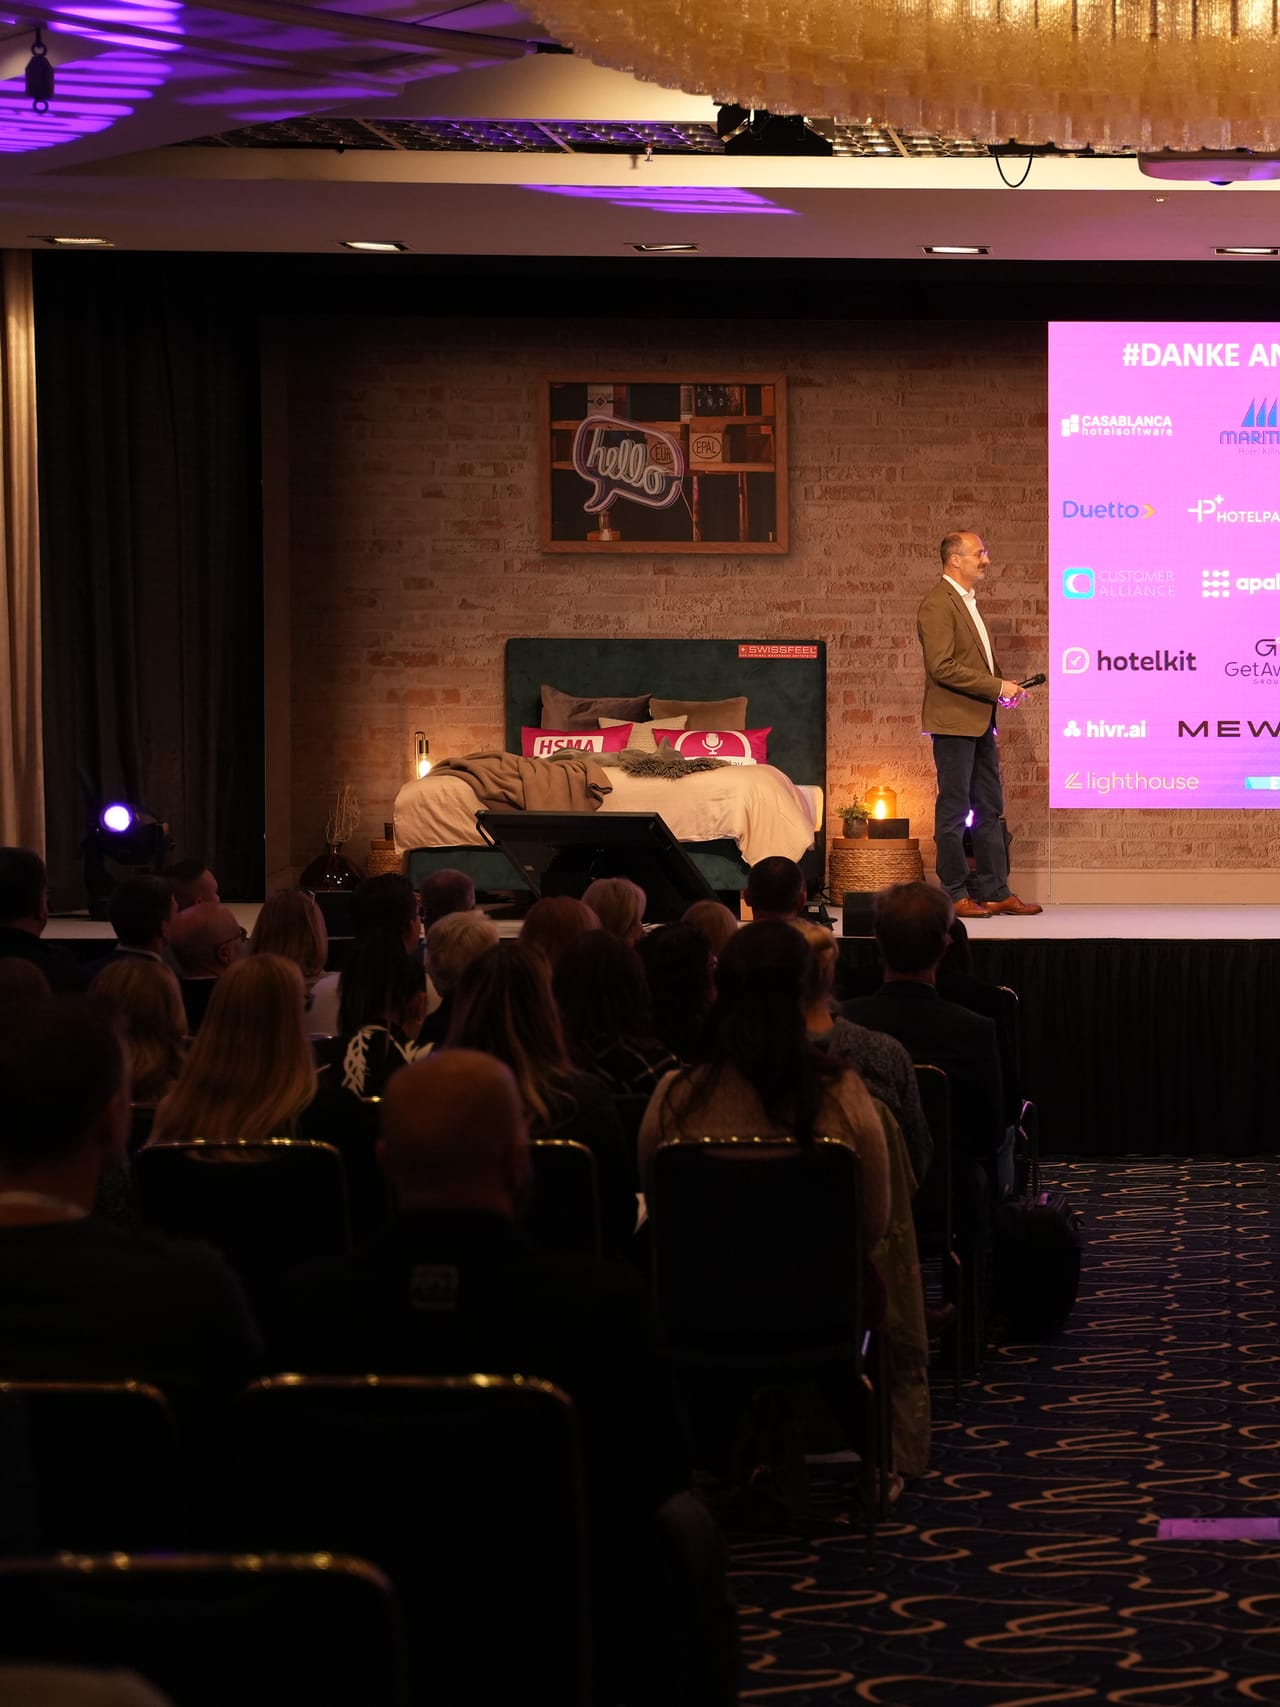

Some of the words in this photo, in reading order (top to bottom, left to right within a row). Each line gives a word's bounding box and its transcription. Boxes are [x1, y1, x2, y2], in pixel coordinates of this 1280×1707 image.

[1122, 343, 1240, 368] #DANKE
[1081, 415, 1173, 426] CASABLANCA
[1081, 427, 1173, 436] hotelsoftware
[697, 441, 717, 454] EPAL
[586, 427, 667, 495] hello
[1062, 500, 1140, 519] Duetto
[1098, 570, 1175, 583] CUSTOMER
[1098, 585, 1177, 598] ALLIANCE
[748, 645, 817, 654] SWISSFEEL
[1097, 649, 1198, 671] hotelkit
[1086, 719, 1147, 738] hivr.ai
[538, 739, 595, 755] HSMA
[1087, 772, 1200, 794] lighthouse
